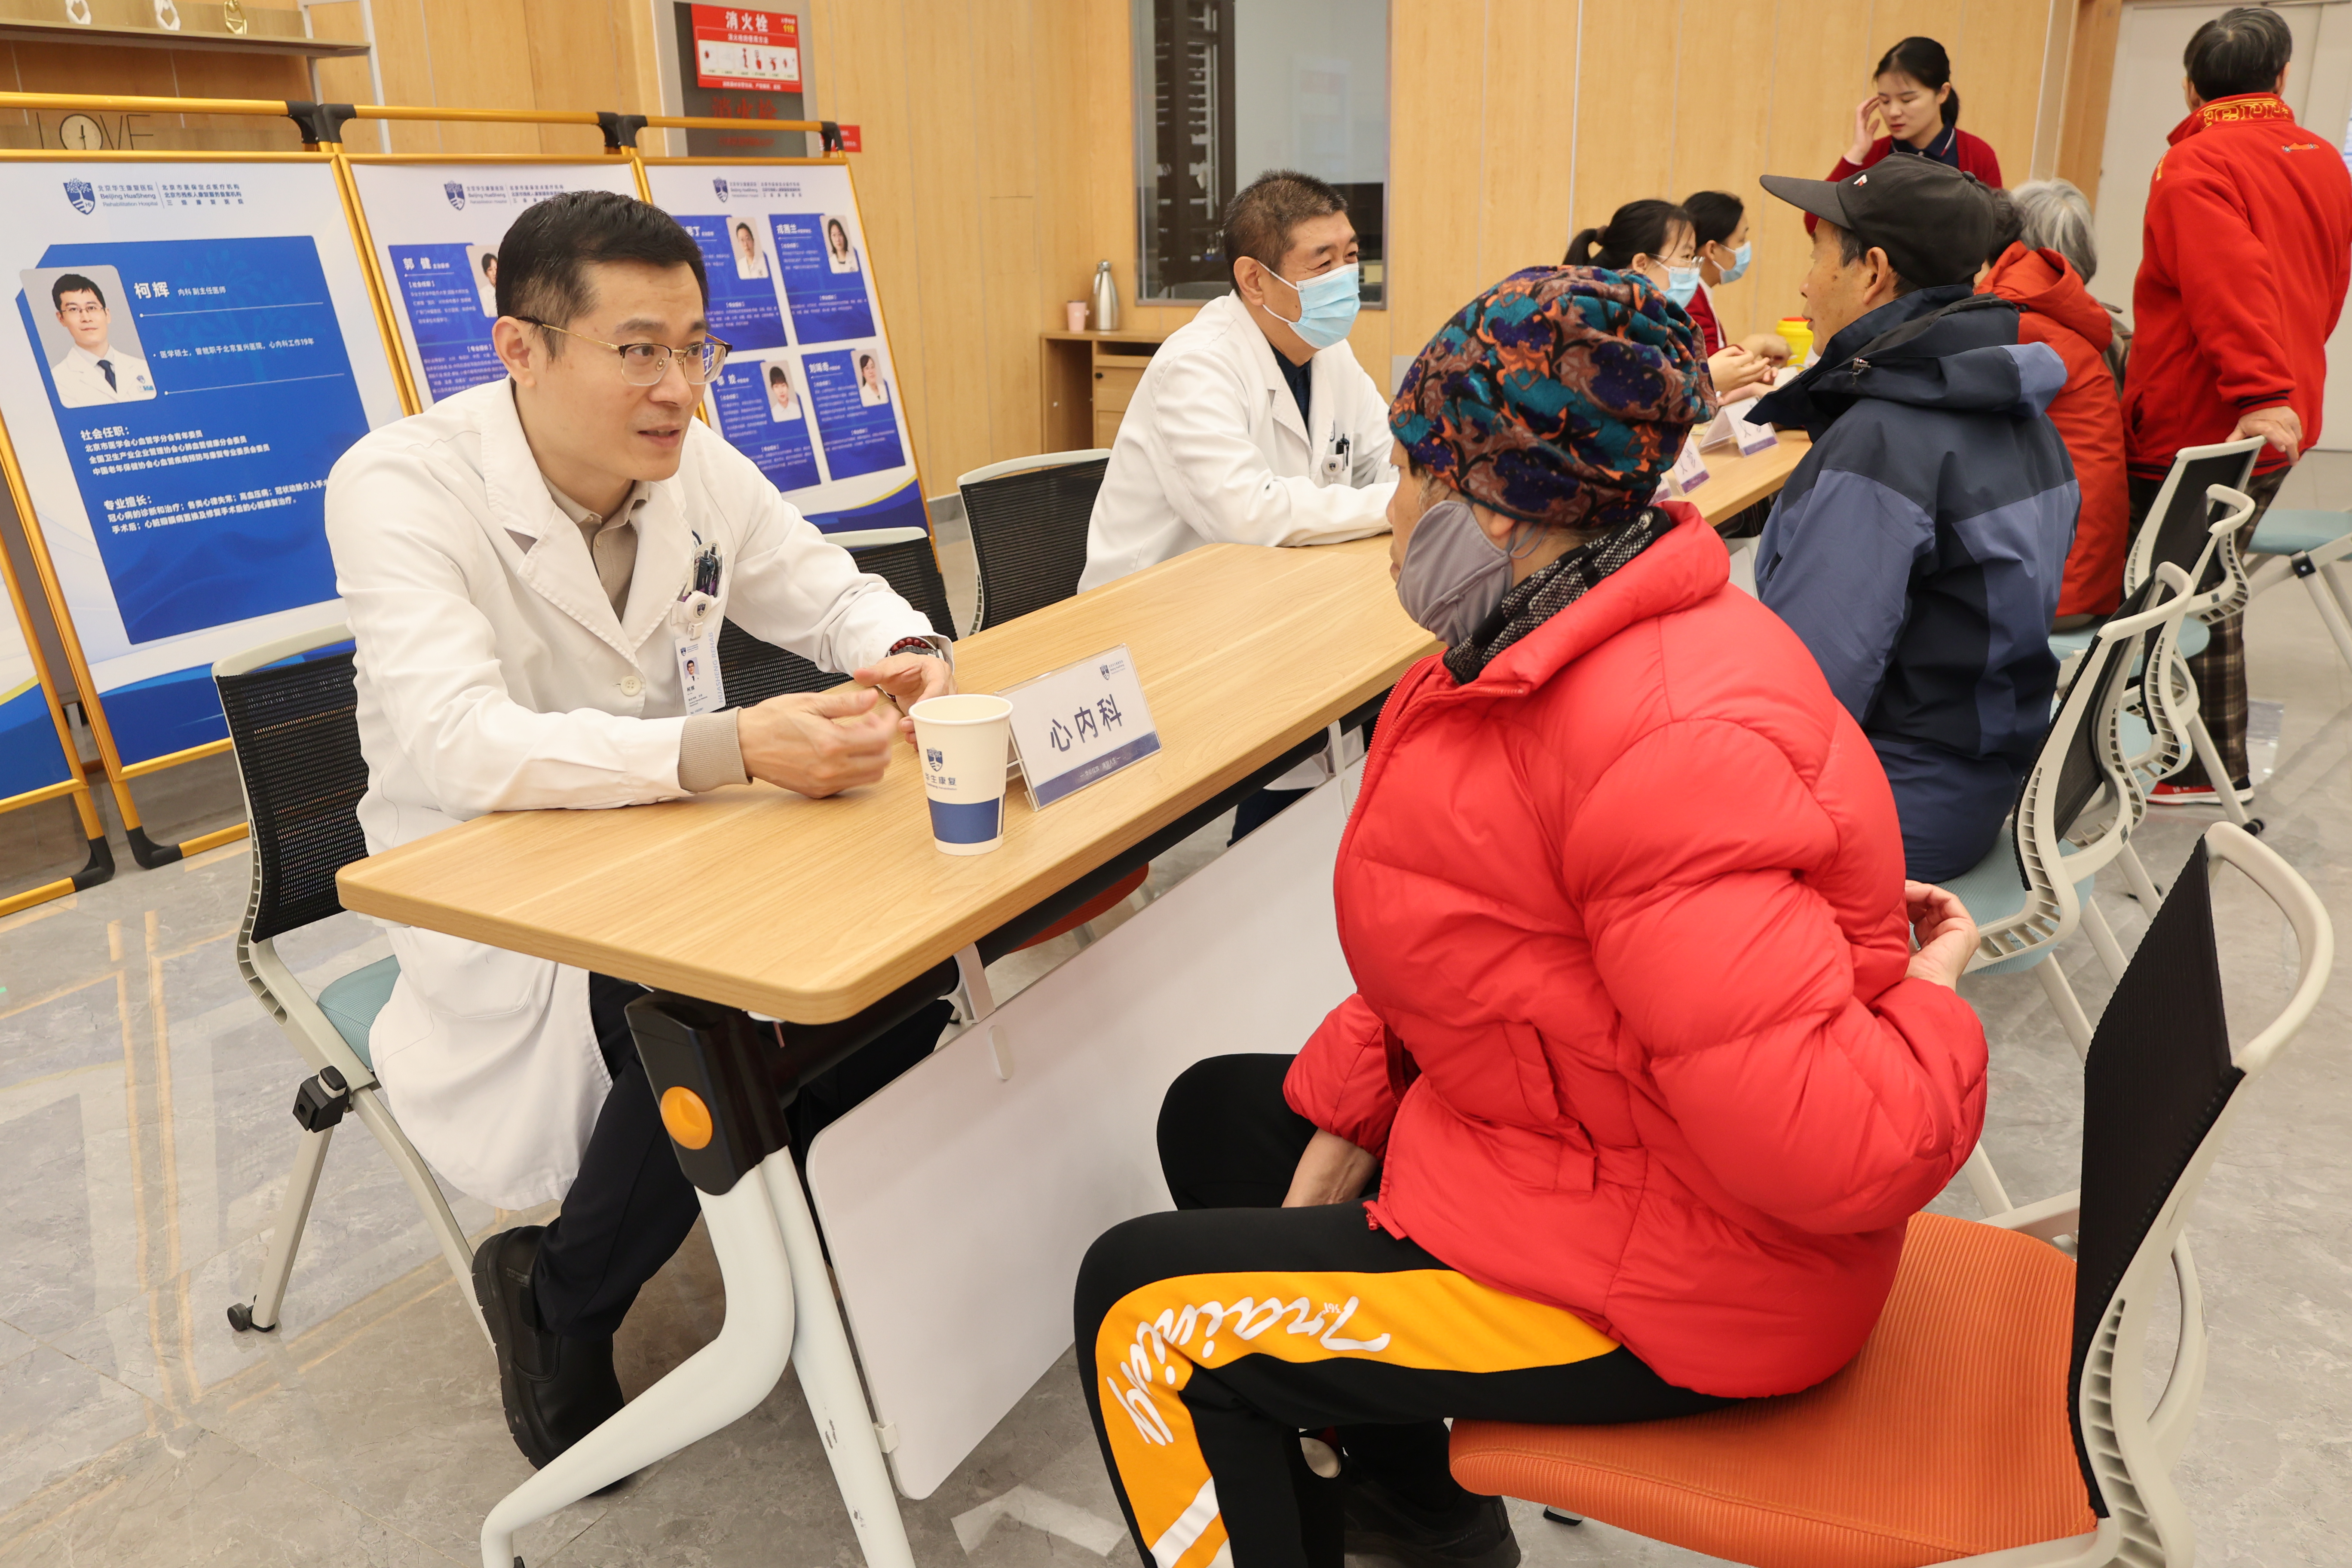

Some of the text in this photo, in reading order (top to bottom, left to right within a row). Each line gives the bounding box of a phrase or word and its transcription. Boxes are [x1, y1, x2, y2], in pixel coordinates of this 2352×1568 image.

[725, 10, 769, 32] 消火栓
[727, 33, 769, 44] 消火栓的使用方法
[134, 281, 170, 299] 柯辉
[178, 286, 226, 297] 内科 副主任医师
[84, 429, 203, 453] 北京市医学会心血管学分会青年委员
[708, 632, 724, 703] HUASHENG REHAB
[1049, 693, 1123, 752] 心内科
[925, 772, 957, 786] 华生康复
